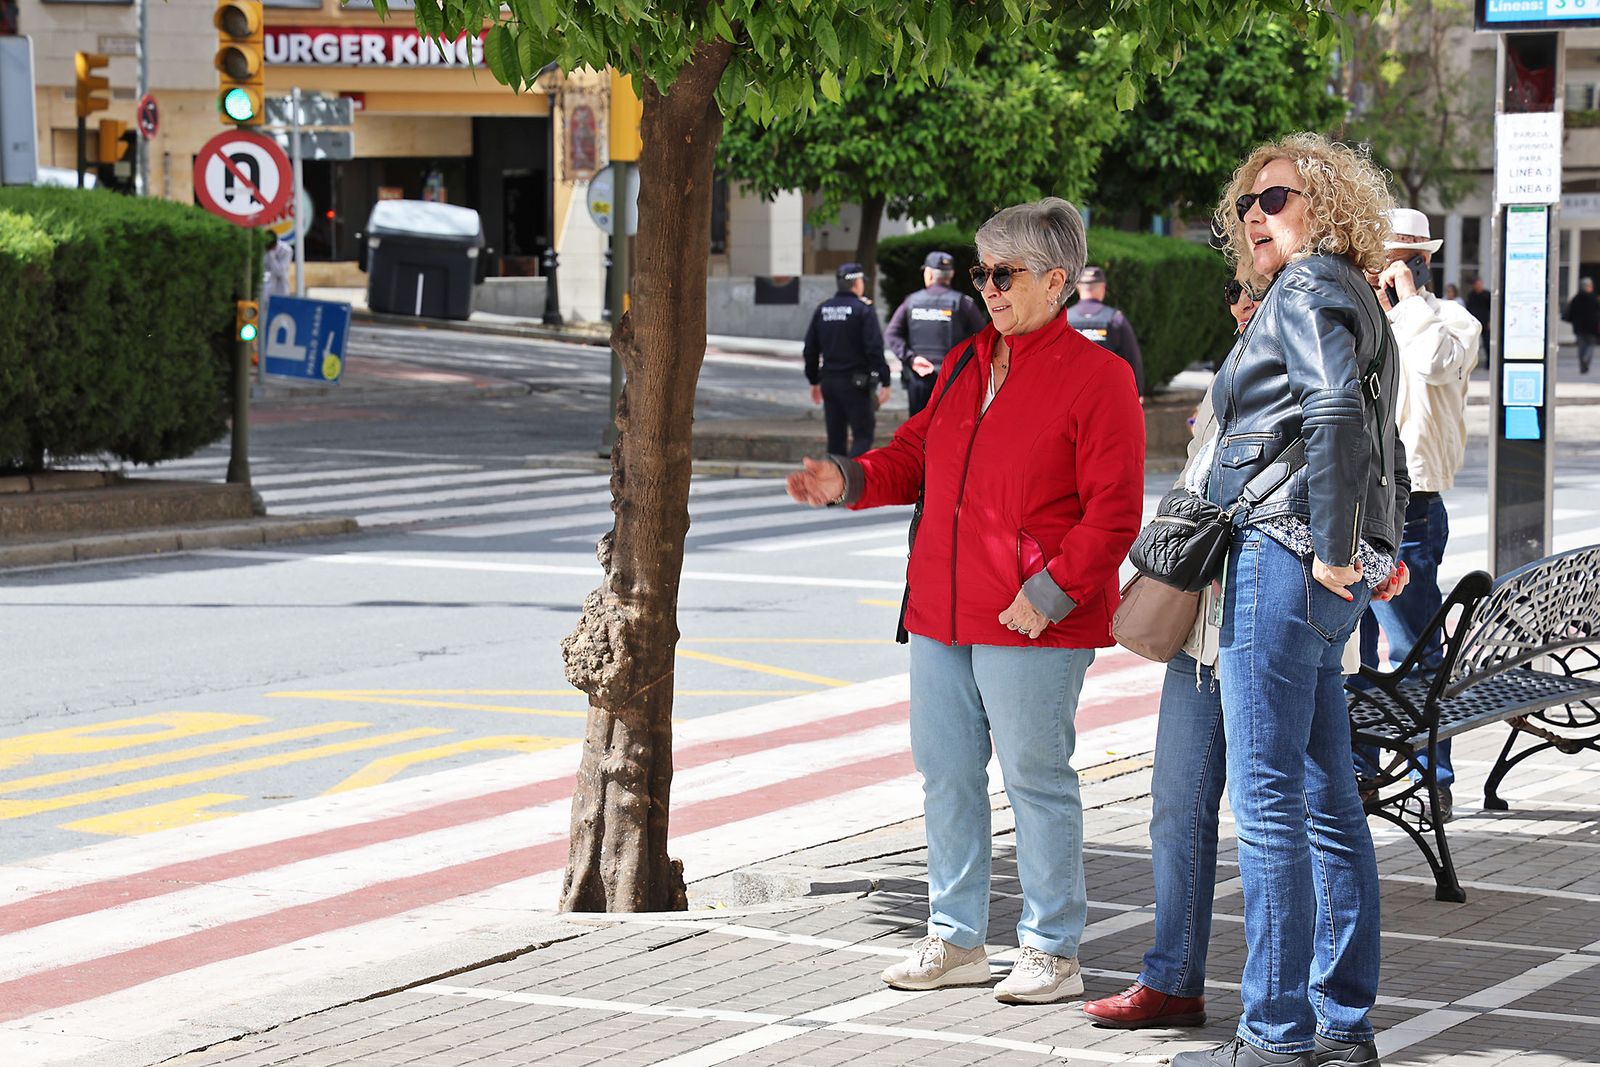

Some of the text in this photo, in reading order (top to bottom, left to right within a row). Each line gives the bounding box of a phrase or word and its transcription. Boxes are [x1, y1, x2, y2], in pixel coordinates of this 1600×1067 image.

[263, 33, 483, 65] URGER KING
[267, 313, 306, 361] P
